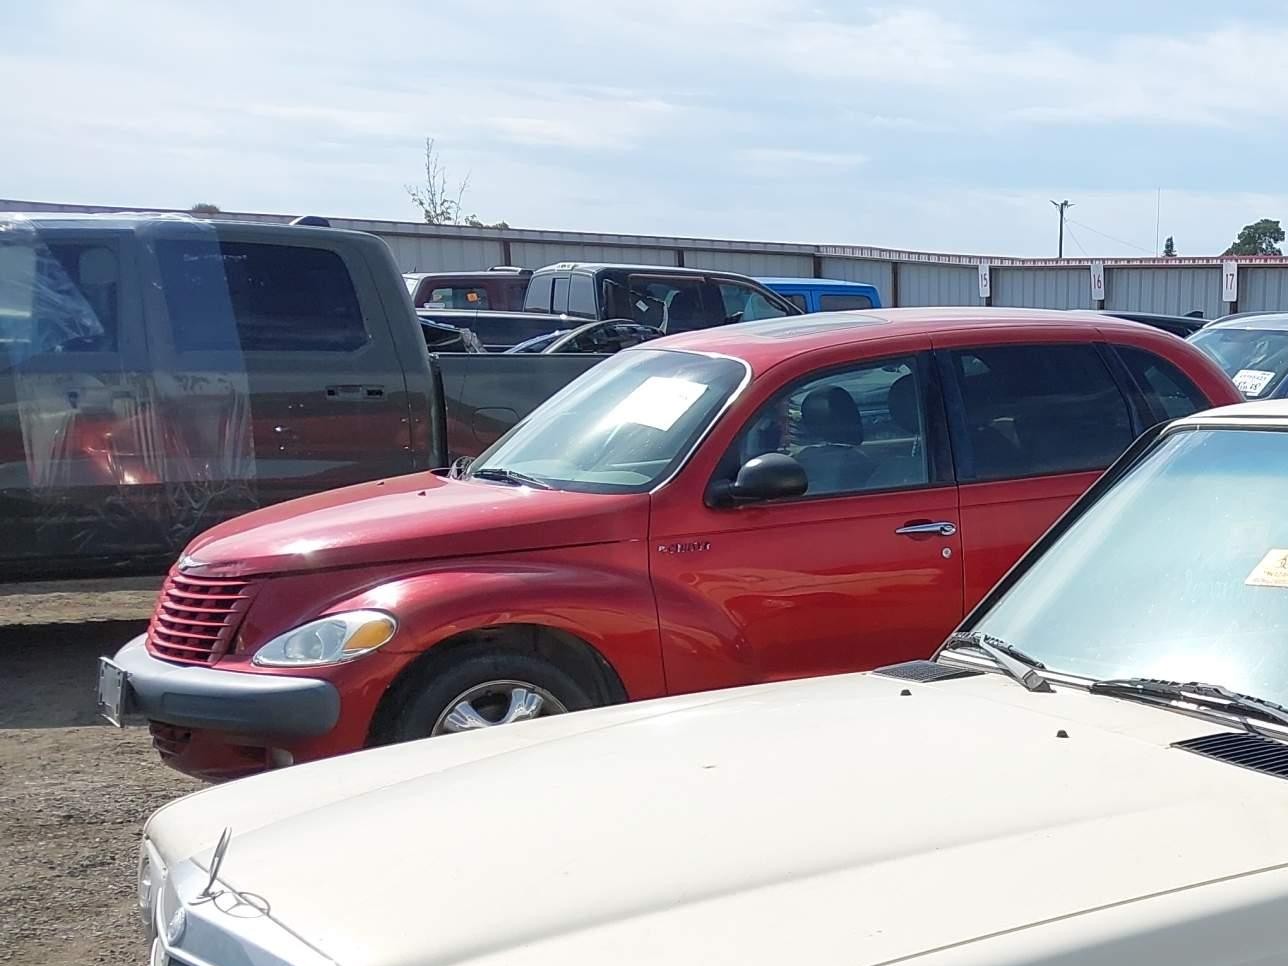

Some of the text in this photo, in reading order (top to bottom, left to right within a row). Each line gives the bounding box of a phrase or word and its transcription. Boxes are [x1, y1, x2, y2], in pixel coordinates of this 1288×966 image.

[980, 272, 988, 288] 15
[1092, 273, 1102, 289] 16
[1225, 273, 1235, 291] 17
